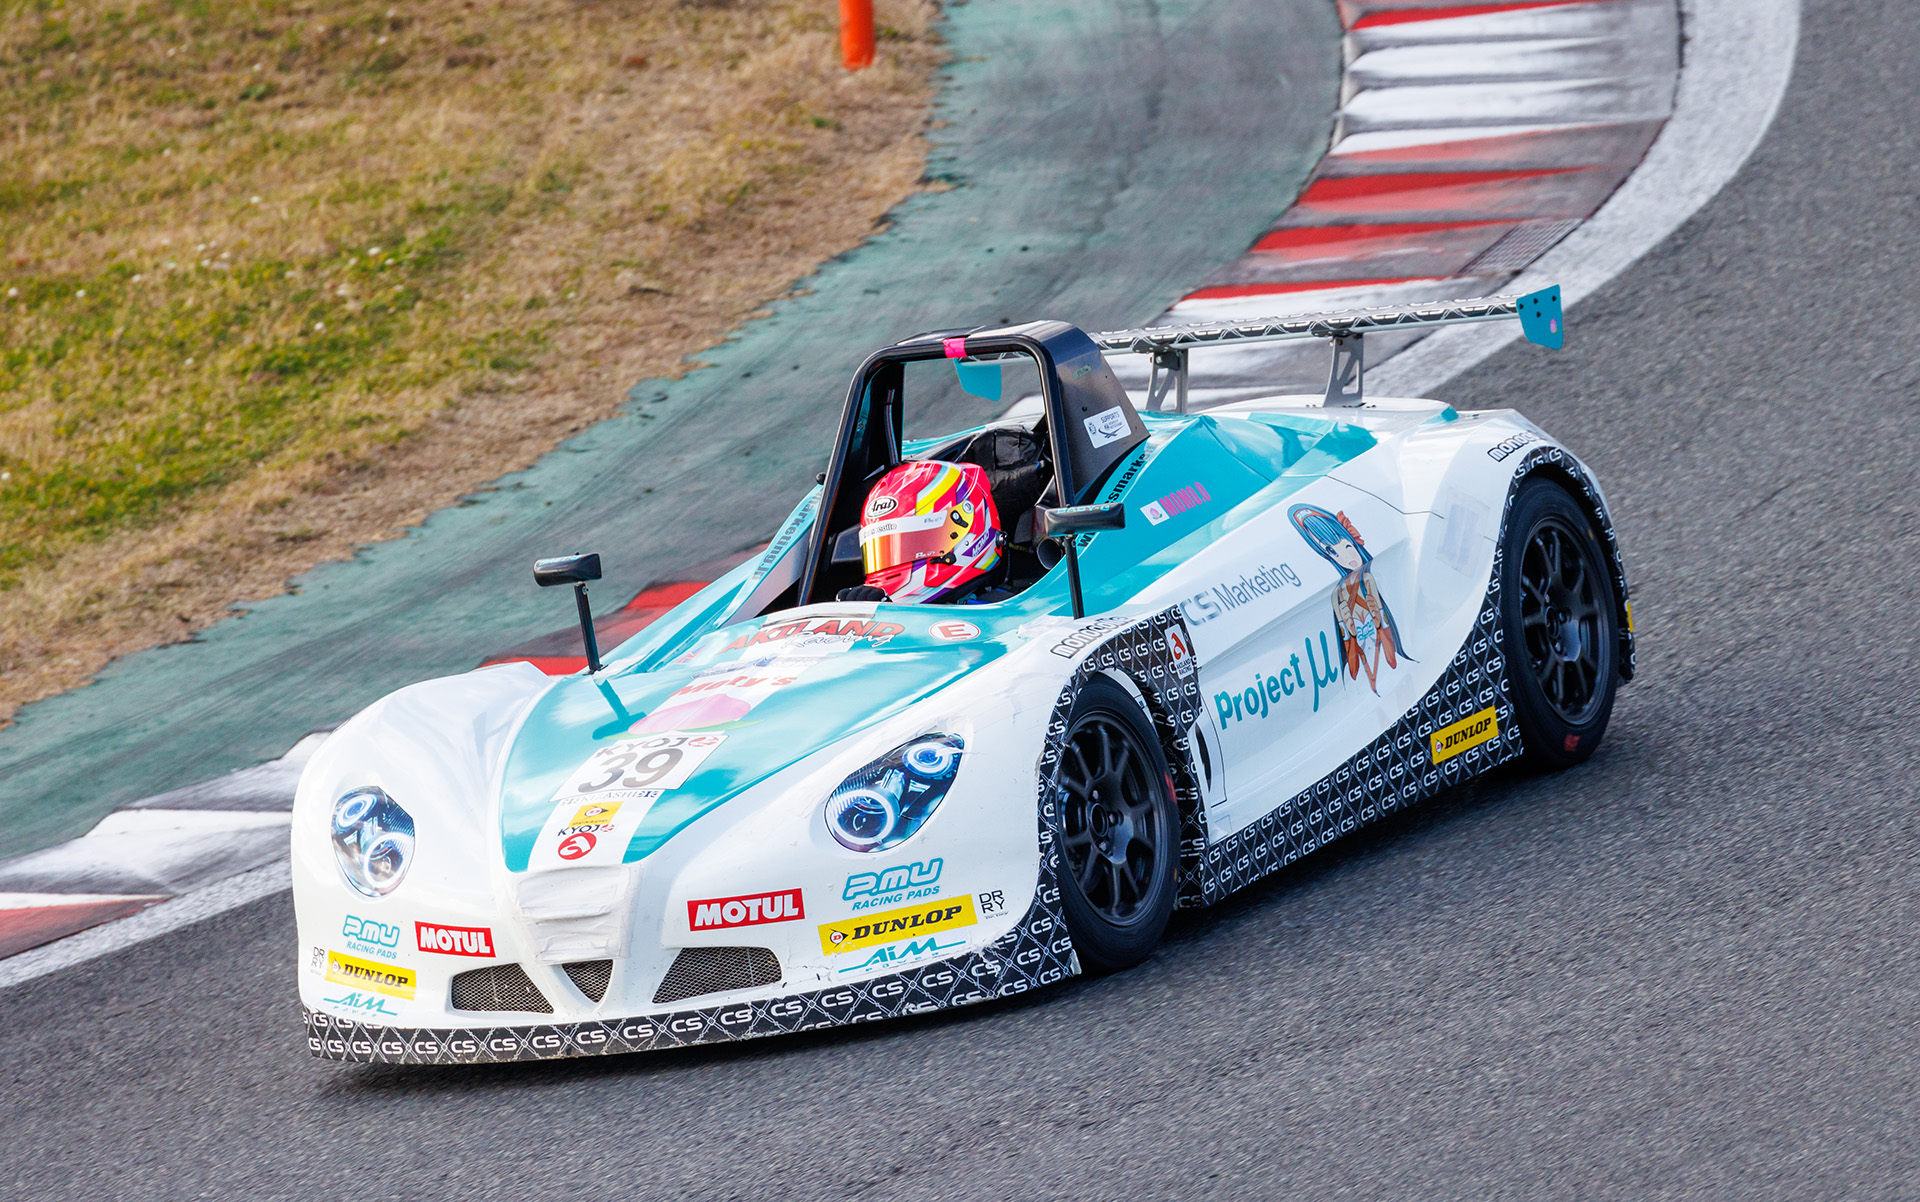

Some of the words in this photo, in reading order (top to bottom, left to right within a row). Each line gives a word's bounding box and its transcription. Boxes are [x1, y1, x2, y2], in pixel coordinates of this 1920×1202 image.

[1549, 448, 1562, 461] CS
[871, 500, 893, 513] Arai
[1179, 590, 1222, 627] CS
[1211, 560, 1302, 613] Marketing
[1153, 613, 1166, 625] CS
[1480, 608, 1494, 624] CS
[781, 631, 895, 648] Racing
[938, 624, 971, 638] E
[1082, 658, 1096, 672] CS
[1101, 654, 1114, 666] CS
[1118, 648, 1131, 661] CS
[1136, 644, 1148, 656] CS
[1153, 638, 1166, 652] CS
[1473, 638, 1487, 654] CS
[1152, 665, 1164, 678] CS
[1426, 691, 1439, 707] CS
[1446, 680, 1460, 696] CS
[1466, 668, 1479, 684] CS
[1486, 657, 1501, 673] CS
[1167, 687, 1179, 701] CS
[1184, 682, 1196, 695] CS
[1181, 710, 1193, 723] CS
[1445, 717, 1491, 749] DUNLOP
[578, 748, 684, 793] 39
[1209, 847, 1220, 864] CS
[1226, 836, 1237, 852] CS
[1244, 824, 1255, 840] CS
[1261, 813, 1273, 828] CS
[1279, 802, 1291, 817] CS
[1298, 790, 1310, 806] CS
[1317, 779, 1329, 794] CS
[1336, 767, 1349, 783] CS
[1356, 756, 1369, 772] CS
[1376, 744, 1390, 760] CS
[1397, 733, 1411, 749] CS
[1418, 721, 1431, 737] CS
[1439, 710, 1452, 726] CS
[1459, 699, 1473, 715] CS
[1479, 687, 1493, 703] CS
[1303, 839, 1315, 855] CS
[1322, 828, 1334, 844] CS
[1341, 816, 1354, 832] CS
[1361, 805, 1375, 821] CS
[1382, 793, 1395, 810] CS
[1403, 782, 1416, 798] CS
[1424, 770, 1437, 786] CS
[1444, 759, 1458, 775] CS
[1465, 747, 1479, 763] CS
[1486, 736, 1500, 752] CS
[1204, 878, 1215, 894] CS
[1220, 866, 1232, 882] CS
[1237, 855, 1249, 871] CS
[1255, 843, 1267, 859] CS
[1273, 832, 1284, 848] CS
[1291, 820, 1303, 836] CS
[1310, 809, 1322, 825] CS
[1328, 797, 1341, 813] CS
[1348, 786, 1361, 802] CS
[1368, 775, 1382, 790] CS
[1390, 763, 1403, 779] CS
[1410, 752, 1424, 768] CS
[694, 893, 800, 926] MOTUL
[852, 893, 902, 911] RACING
[906, 885, 941, 900] PADS
[851, 905, 963, 940] DUNLOP
[1031, 917, 1052, 935] CS
[346, 941, 375, 955] RACING
[376, 948, 398, 959] PADS
[420, 926, 490, 954] MOTUL
[1017, 948, 1041, 965] CS
[1052, 937, 1072, 954] CS
[342, 964, 408, 987] DUNLOP
[1002, 979, 1028, 996] CS
[1040, 967, 1060, 985] CS
[309, 1038, 321, 1050] CS
[328, 1040, 344, 1052] CS
[352, 1042, 371, 1054] CS
[382, 1042, 403, 1054] CS
[415, 1042, 438, 1054] CS
[451, 1041, 476, 1053] CS
[490, 1038, 517, 1051] CS
[532, 1035, 560, 1048] CS
[577, 1030, 606, 1044] CS
[623, 1024, 653, 1039] CS
[671, 1017, 703, 1032] CS
[771, 1000, 803, 1016] CS
[821, 991, 853, 1007] CS
[872, 981, 903, 998] CS
[922, 971, 953, 987] CS
[313, 1014, 328, 1026] CS
